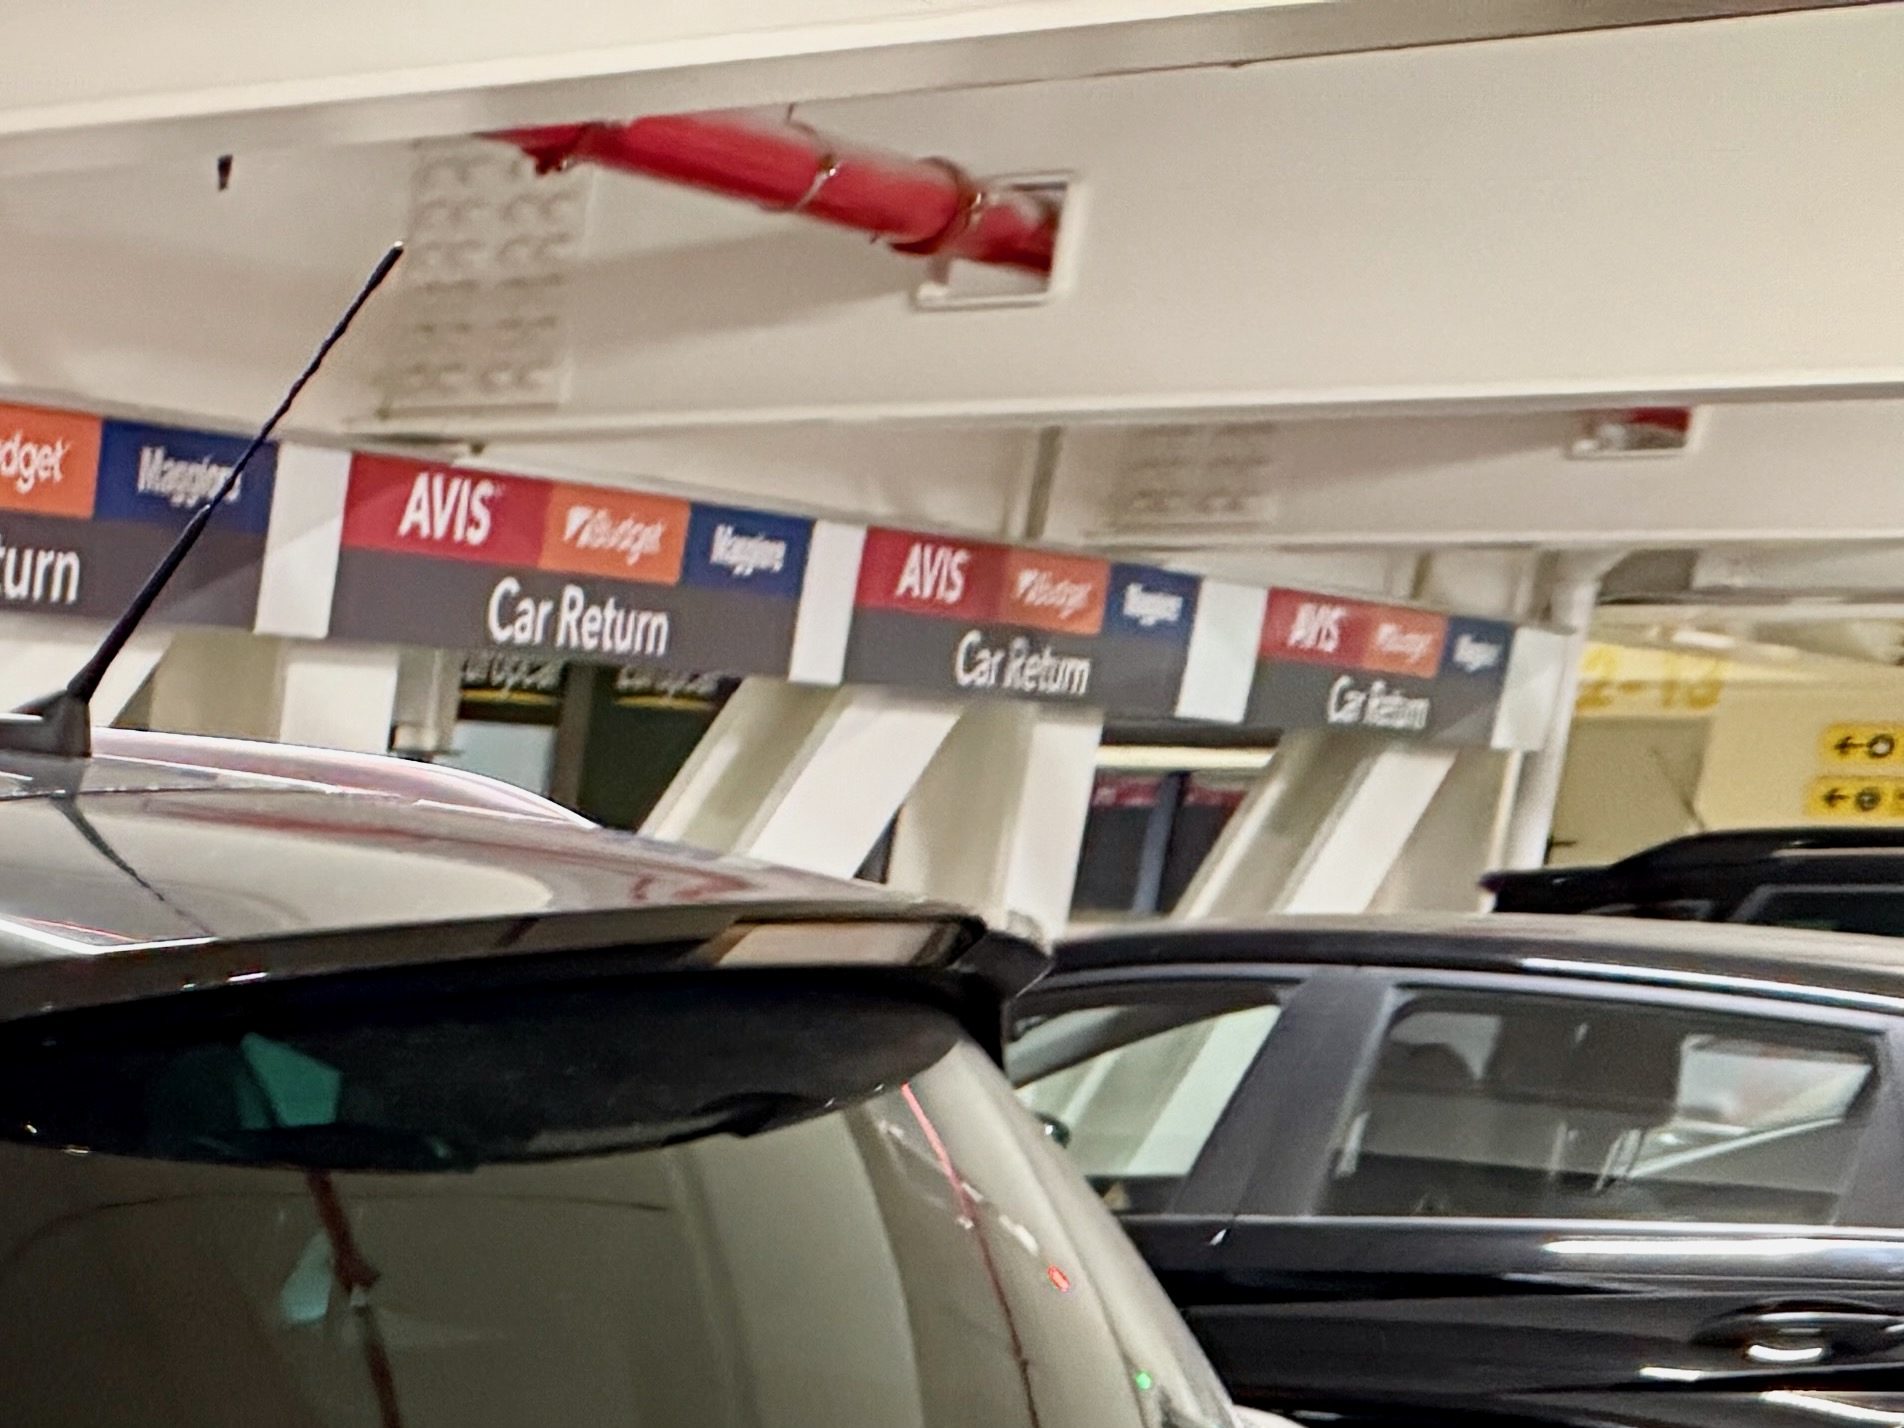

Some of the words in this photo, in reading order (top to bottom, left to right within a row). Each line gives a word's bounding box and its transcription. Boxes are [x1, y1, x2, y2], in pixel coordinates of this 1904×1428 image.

[397, 472, 492, 546] AVIS
[896, 542, 970, 603] AVIS
[488, 576, 553, 646] Car
[556, 584, 670, 656] Return
[954, 630, 1004, 688] Car
[1005, 641, 1090, 697] Return
